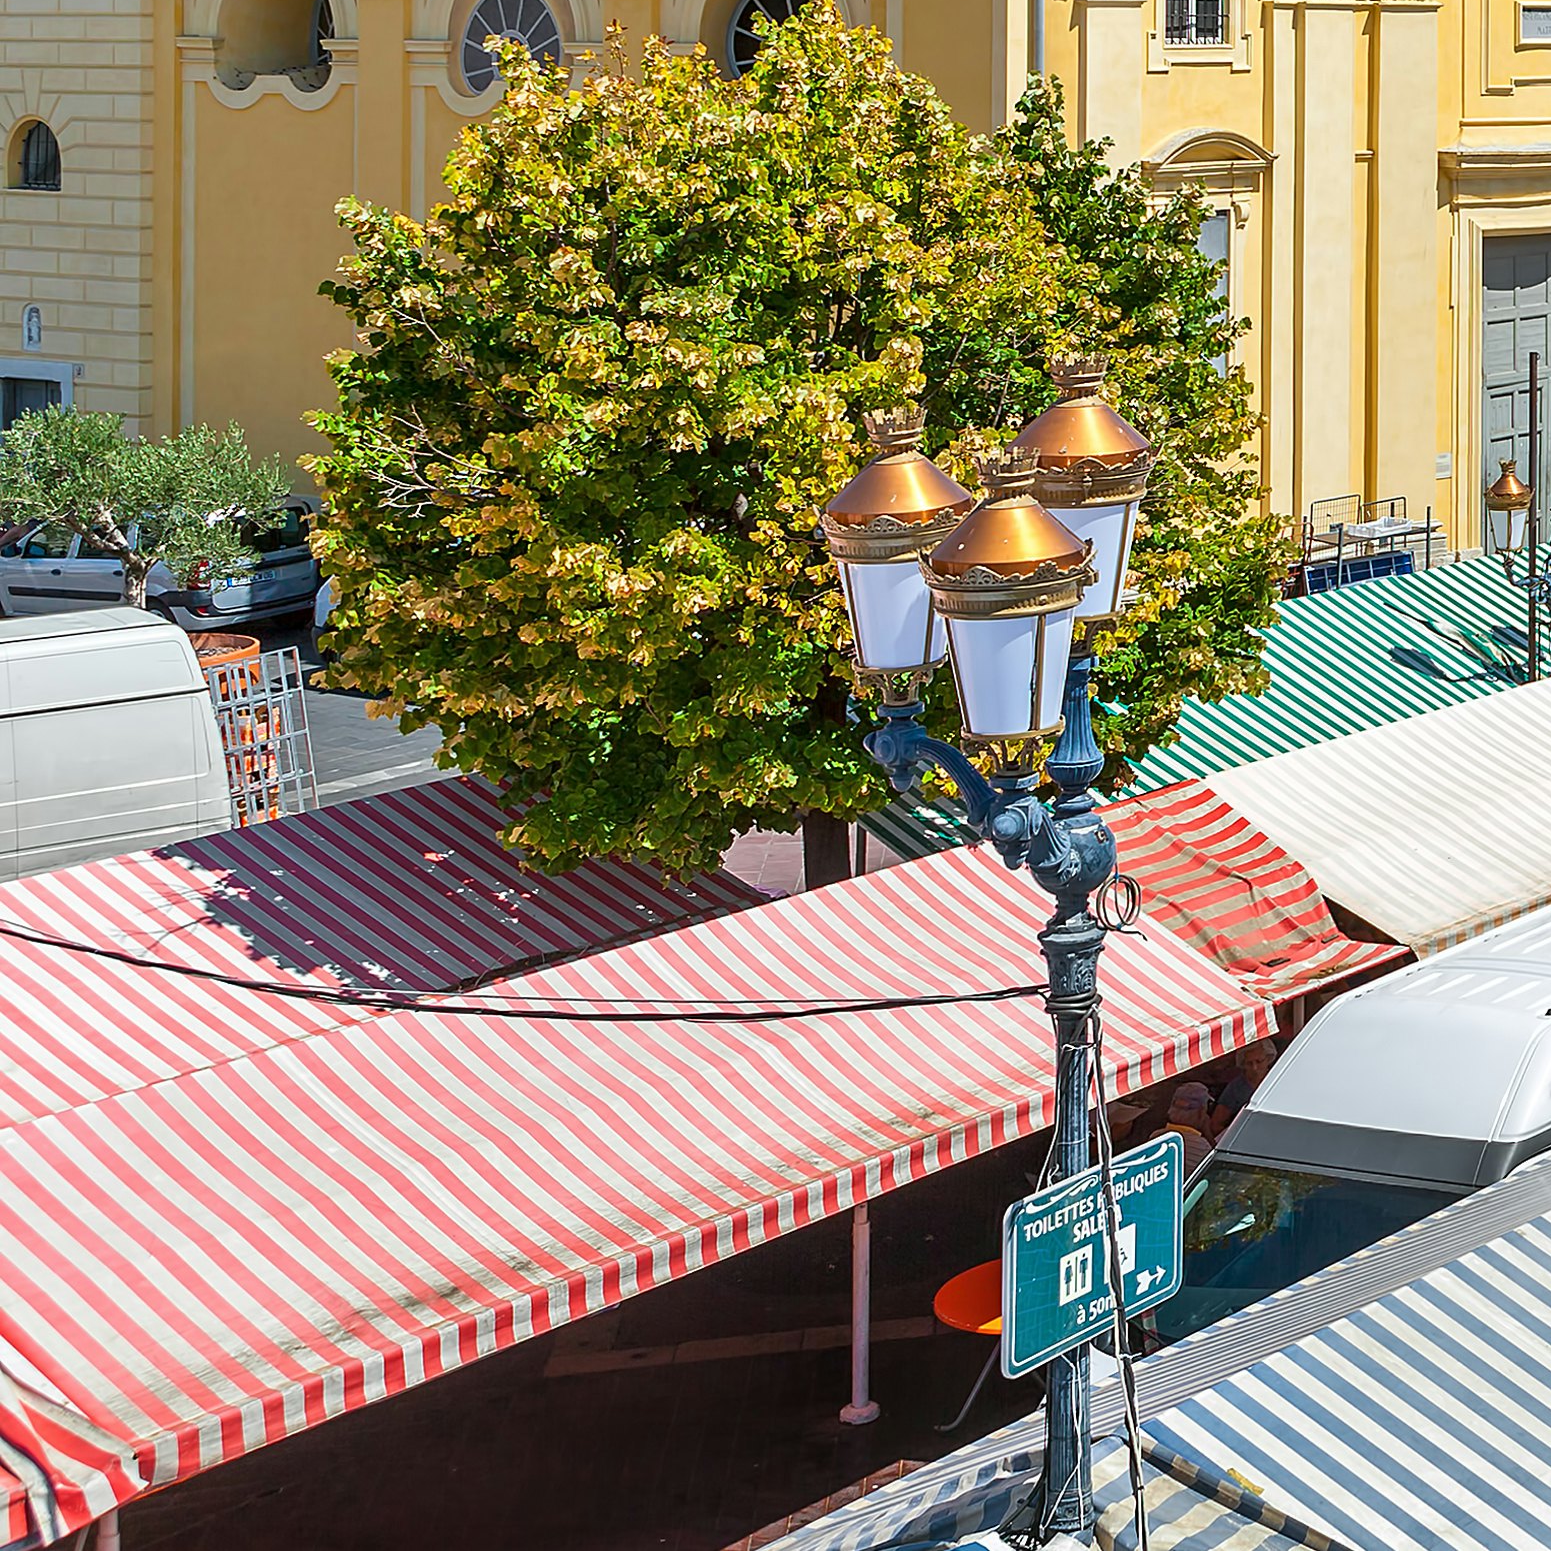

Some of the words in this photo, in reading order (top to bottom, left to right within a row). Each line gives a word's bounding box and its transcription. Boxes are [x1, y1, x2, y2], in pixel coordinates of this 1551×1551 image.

[1023, 1195, 1095, 1242] TOILETTES
[1097, 1162, 1169, 1210] PBLIQUES
[1073, 1204, 1124, 1244] SALEA
[1076, 1303, 1086, 1325] à
